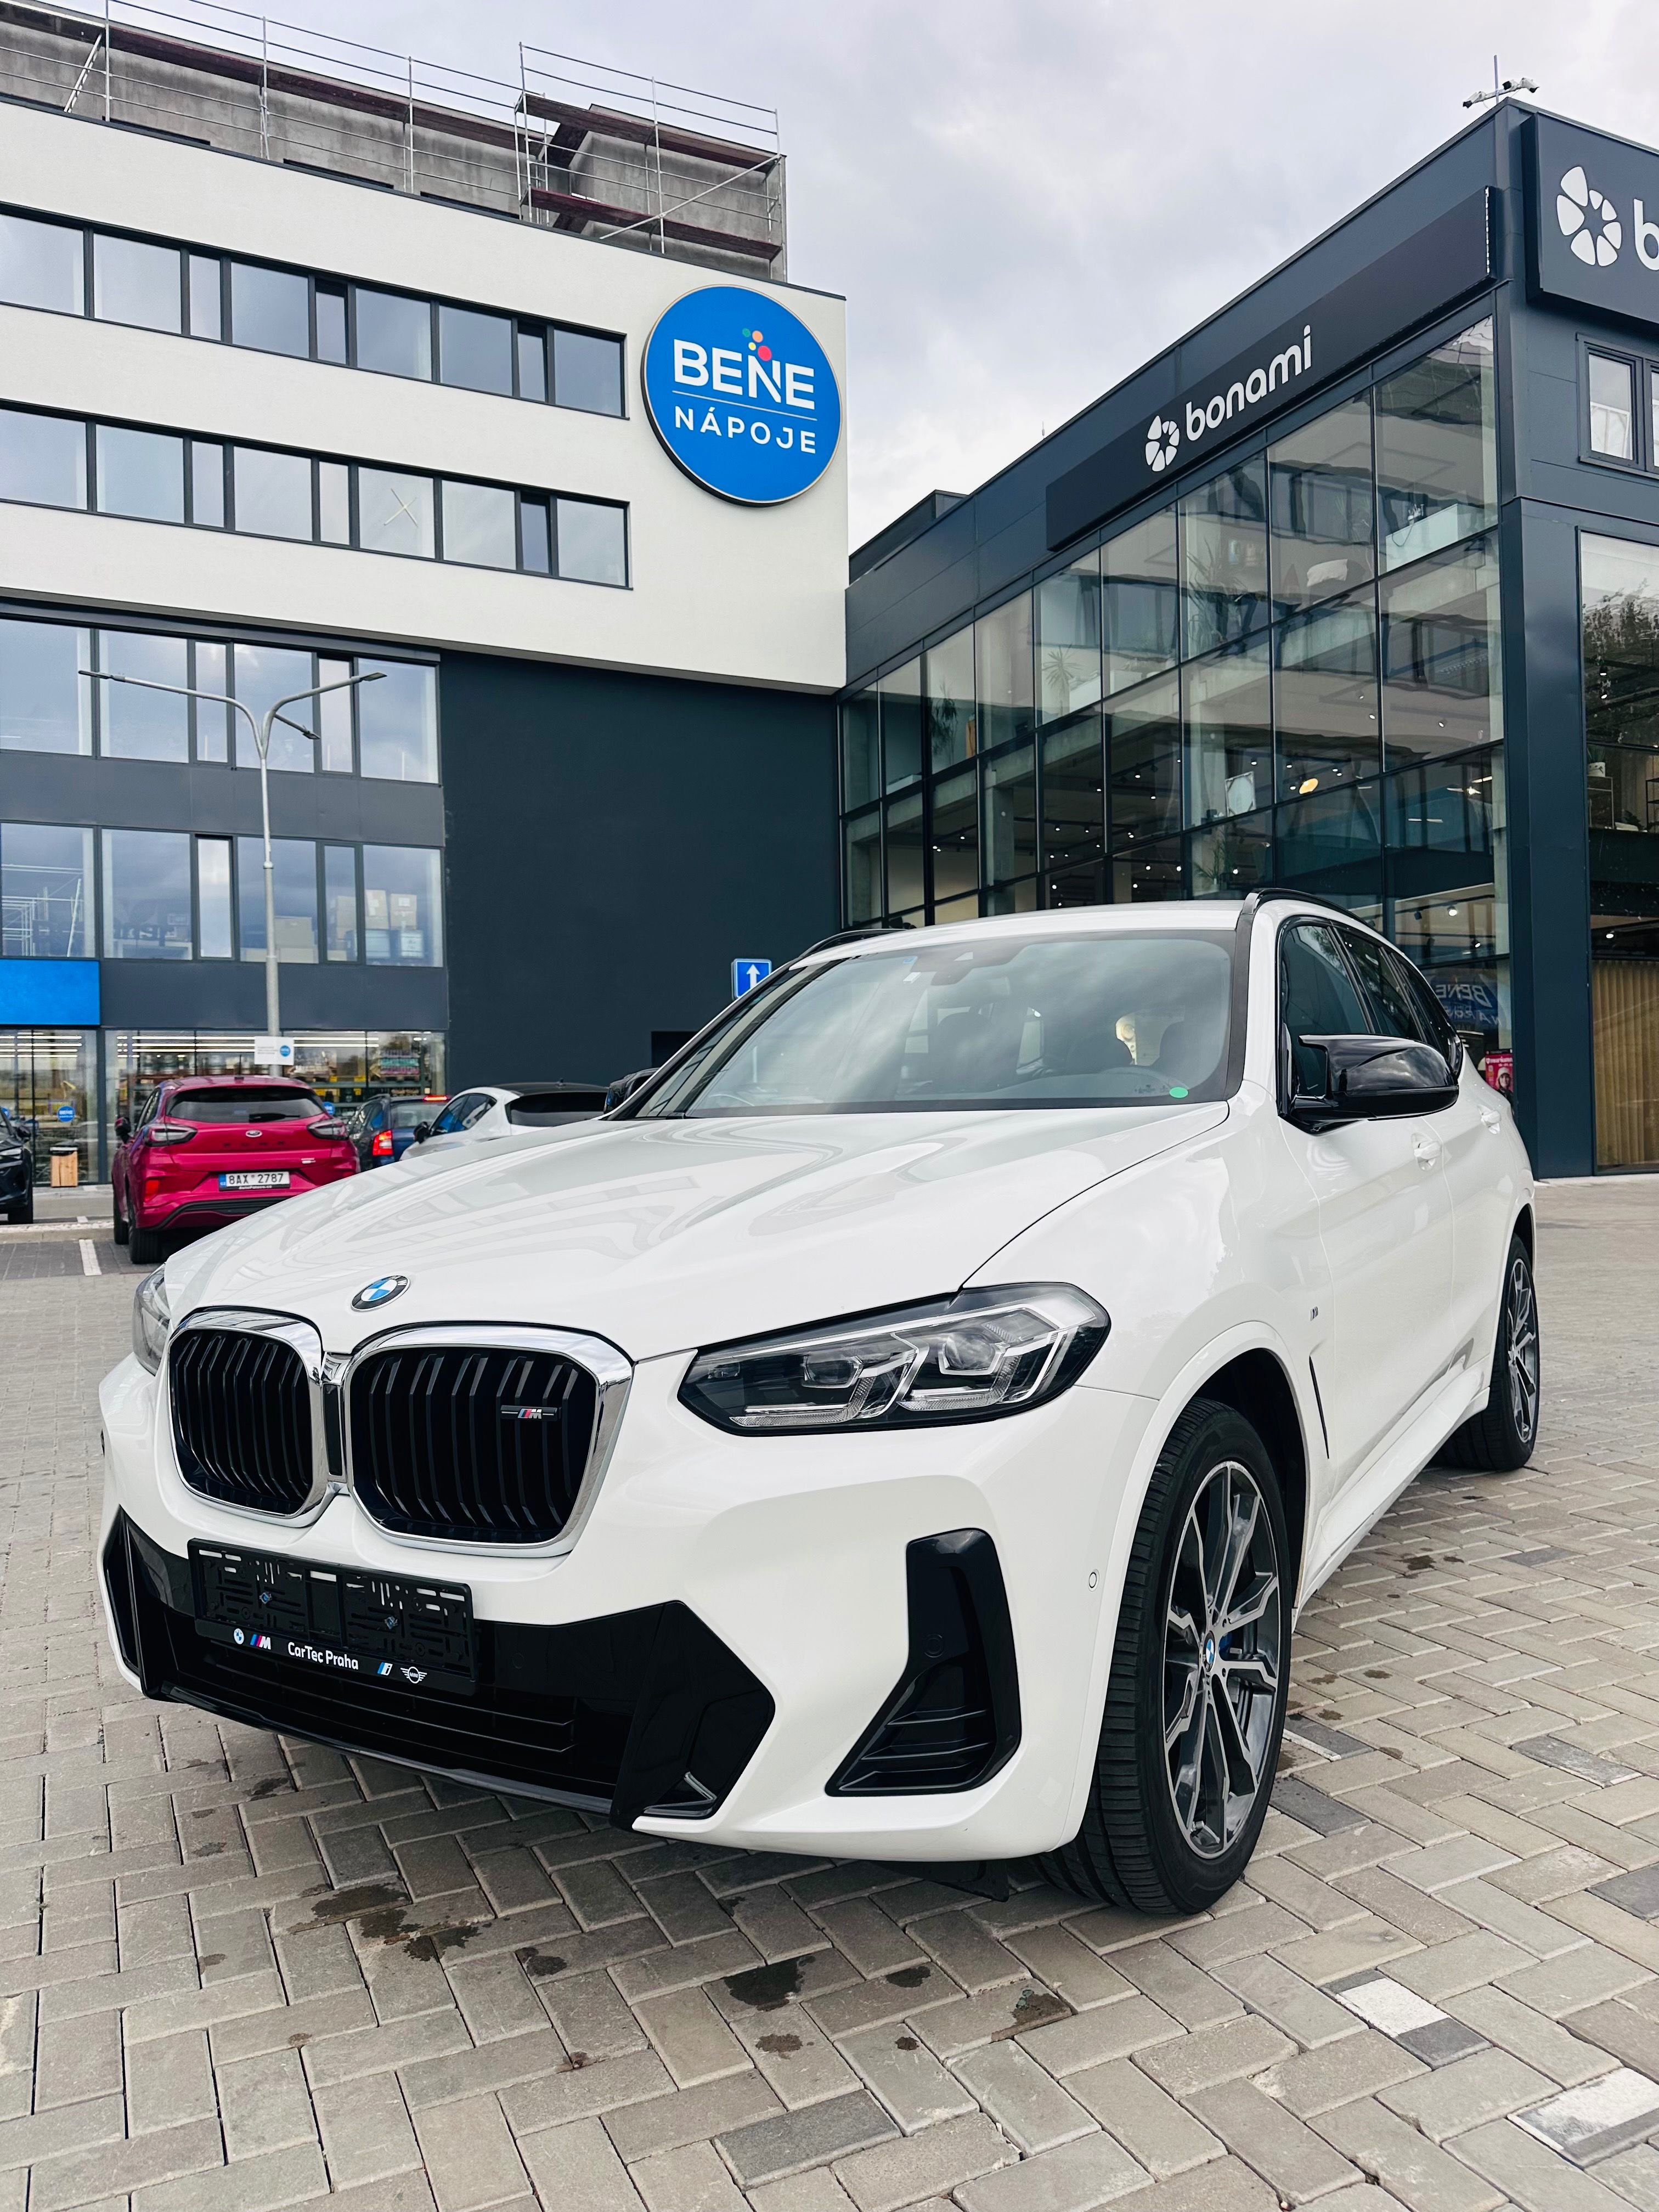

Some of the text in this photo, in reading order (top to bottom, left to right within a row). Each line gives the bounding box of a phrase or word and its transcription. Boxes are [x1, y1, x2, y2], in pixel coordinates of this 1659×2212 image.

[674, 338, 815, 410] BENE
[1186, 324, 1311, 441] bonami
[675, 406, 816, 454] NÁPOJE
[229, 1173, 284, 1184] 8AX 2787
[259, 1636, 271, 1650] M
[288, 1642, 359, 1670] CarTec Praha
